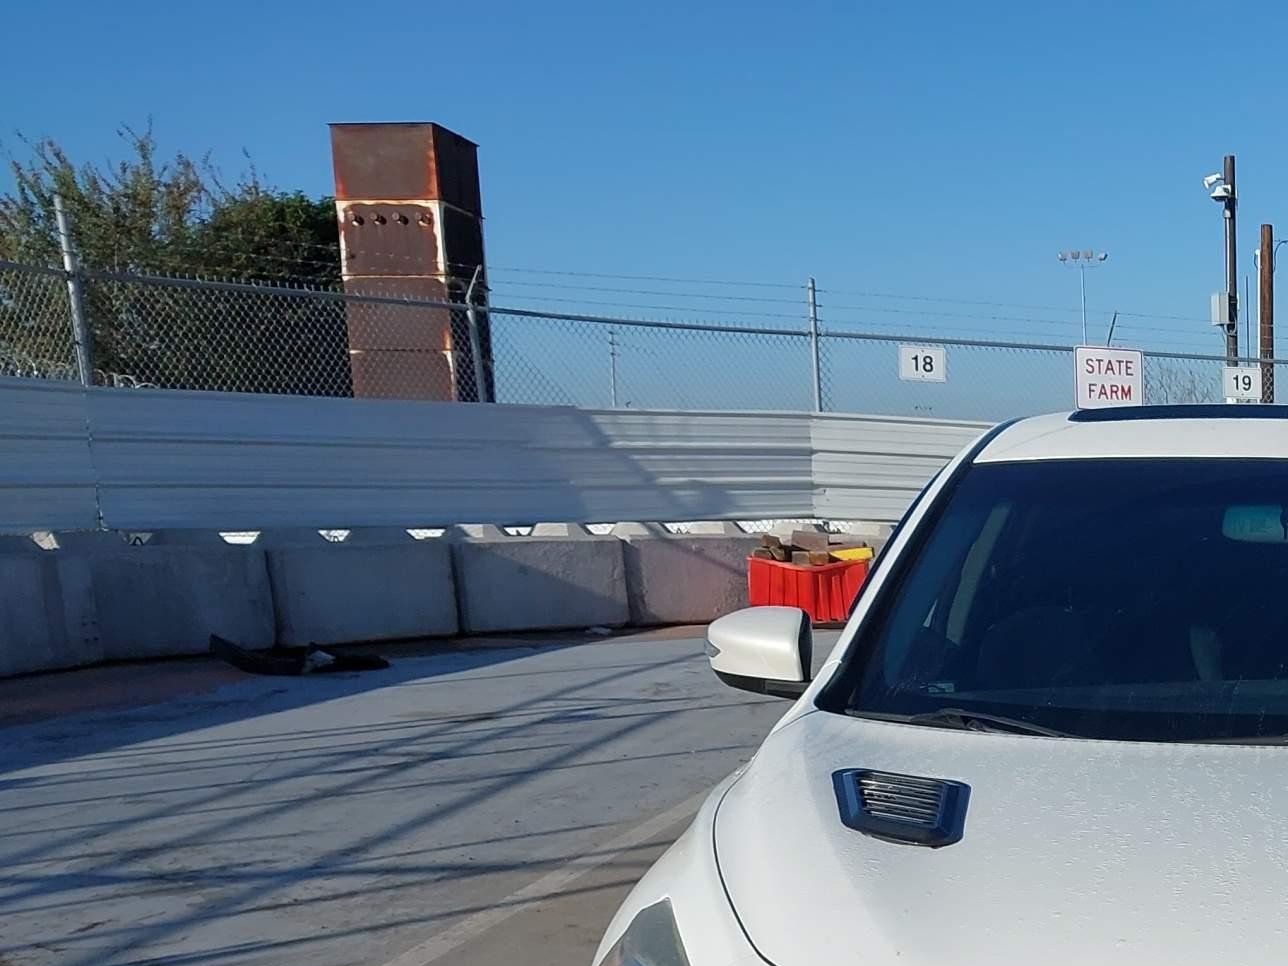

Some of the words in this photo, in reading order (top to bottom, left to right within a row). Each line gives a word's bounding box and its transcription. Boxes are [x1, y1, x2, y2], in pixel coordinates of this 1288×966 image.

[911, 354, 934, 373] 18
[1085, 358, 1134, 376] STATE
[1088, 383, 1132, 401] FARM
[1232, 374, 1252, 392] 19
